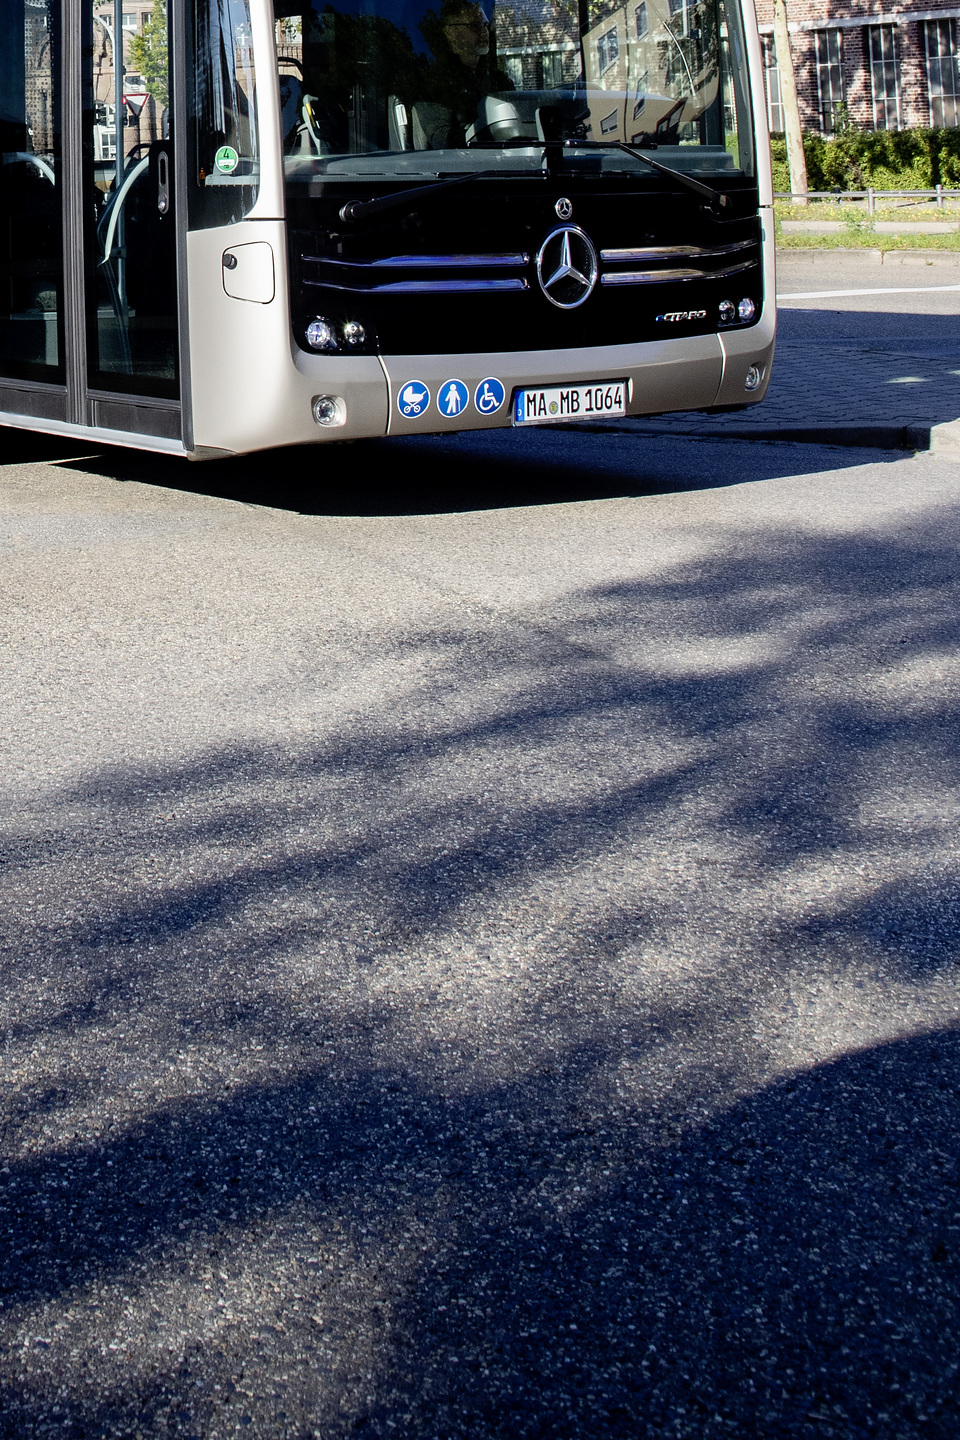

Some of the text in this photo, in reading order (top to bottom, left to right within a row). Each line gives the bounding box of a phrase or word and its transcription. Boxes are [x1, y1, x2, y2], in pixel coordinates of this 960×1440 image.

[224, 148, 230, 159] 4
[526, 392, 547, 418] MA
[560, 390, 580, 414] MB
[584, 386, 623, 412] 1064
